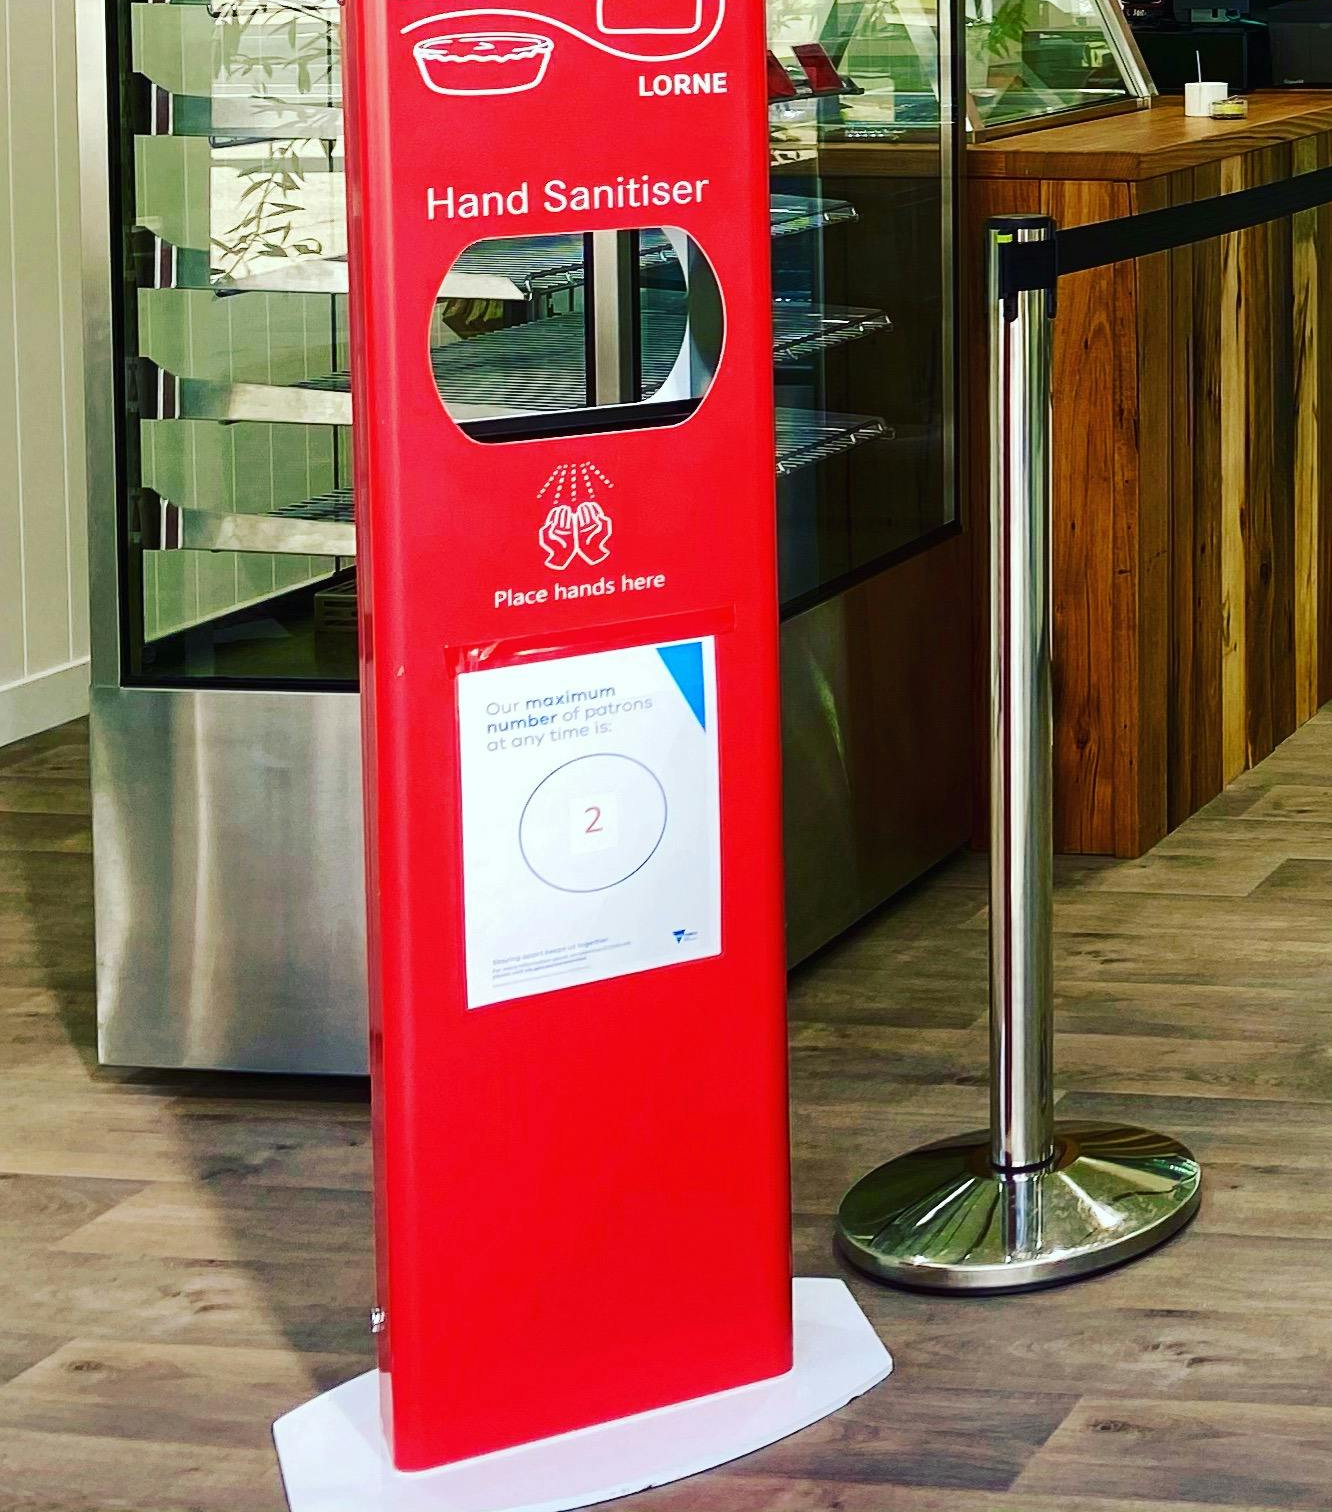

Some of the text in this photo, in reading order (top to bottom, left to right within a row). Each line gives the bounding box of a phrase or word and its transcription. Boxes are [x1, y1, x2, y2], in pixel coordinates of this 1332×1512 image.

[638, 72, 728, 98] LORNE
[427, 175, 710, 220] Hand Sanitiser
[494, 573, 666, 608] Place hands here
[486, 685, 616, 717] Our maximum
[487, 696, 653, 734] number of patrons
[487, 737, 507, 752] at
[511, 734, 545, 751] any
[550, 724, 590, 743] time
[585, 805, 603, 834] 2
